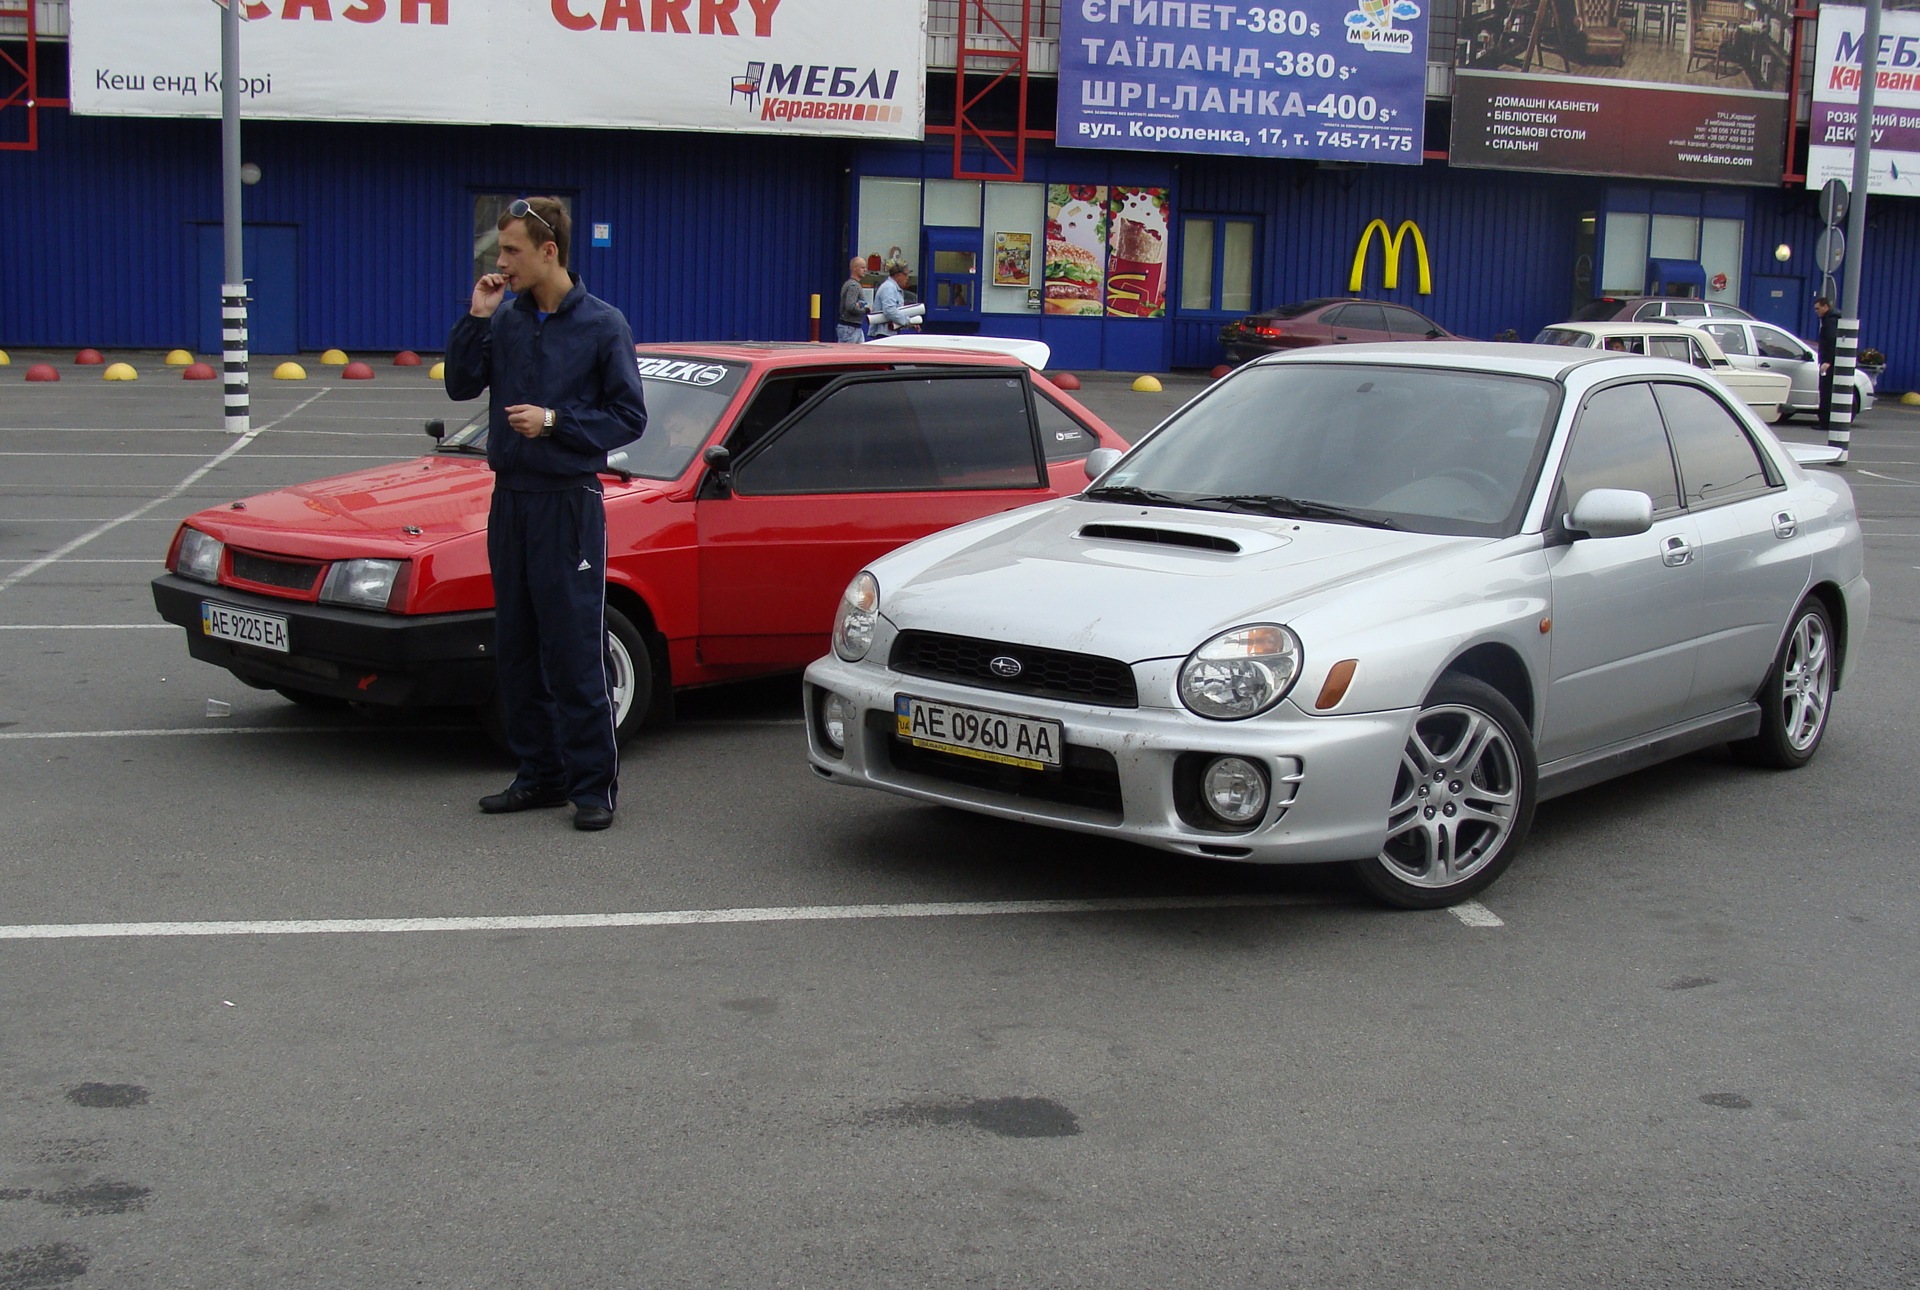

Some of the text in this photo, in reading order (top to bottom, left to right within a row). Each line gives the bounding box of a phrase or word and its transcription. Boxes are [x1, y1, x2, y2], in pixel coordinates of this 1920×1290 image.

[1383, 31, 1410, 44] МИР
[1835, 31, 1920, 69] МЕБ
[96, 69, 145, 91] Кеш
[152, 75, 197, 96] енд
[766, 63, 899, 100] МЕБЛІ
[1828, 66, 1914, 92] Карван
[760, 97, 853, 122] Караван
[1494, 96, 1600, 112] ДОМАШНІ КАБІНЕТИ
[1494, 110, 1557, 123] БІБЛІОТЕКИ
[1827, 110, 1897, 127] РОЗКНИЙ
[1079, 121, 1413, 152] вул. Короленка, 17, т. 745-71-75
[1493, 125, 1586, 140] ПИСЬМОВІ СТОЛИ
[1824, 125, 1884, 143] ДЕКУ
[1492, 139, 1539, 152] СПАЛЬНІ
[1678, 153, 1753, 166] www.skano.com
[212, 610, 285, 647] AE 9225 EA
[912, 705, 946, 738] AE
[951, 712, 1008, 749] 0960
[1015, 723, 1053, 758] AA
